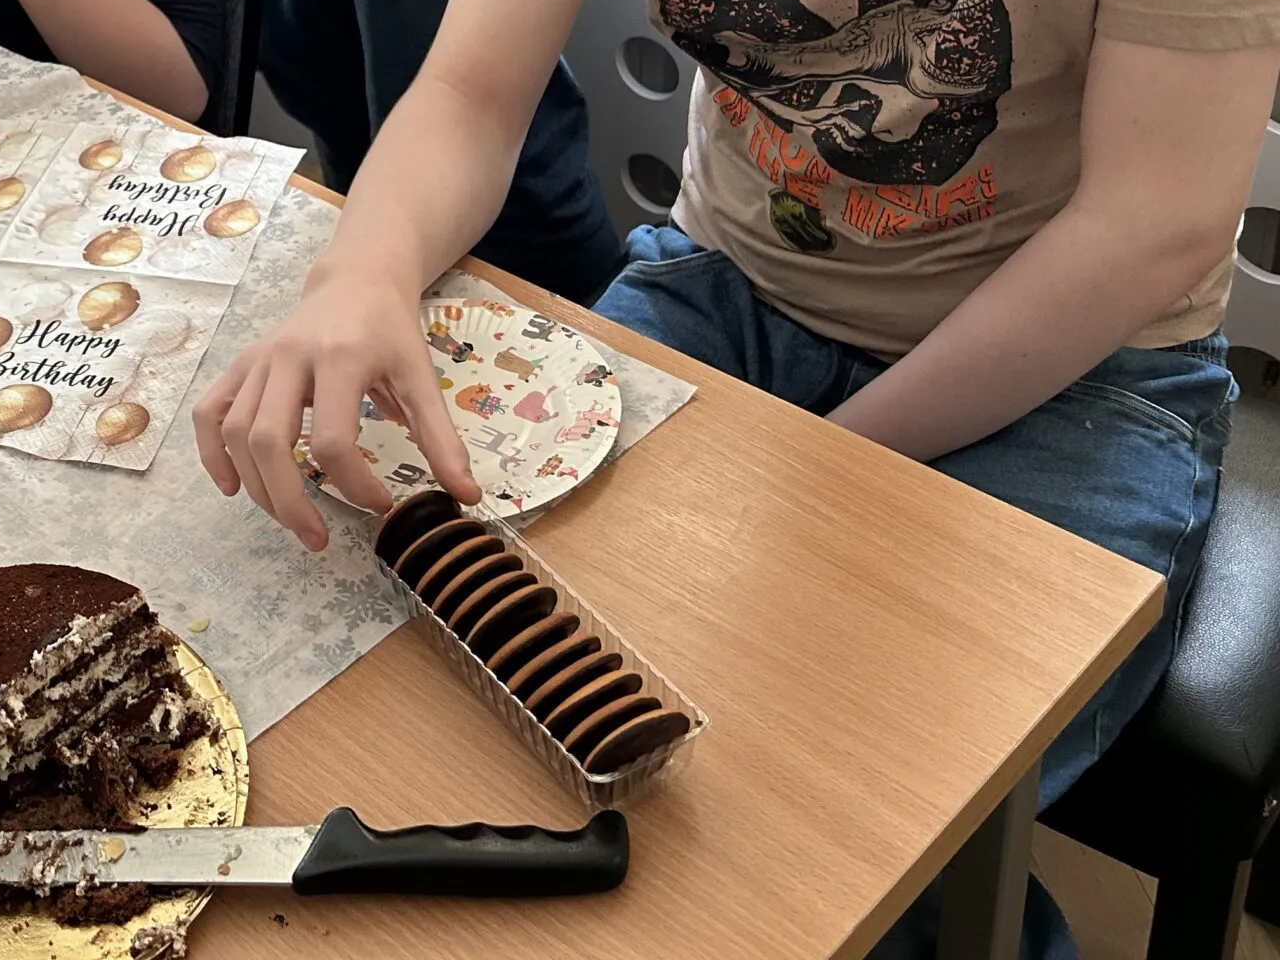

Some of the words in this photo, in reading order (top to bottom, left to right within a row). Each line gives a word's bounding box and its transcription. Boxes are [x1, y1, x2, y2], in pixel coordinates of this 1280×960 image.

[108, 174, 229, 209] Birthday
[98, 203, 202, 237] Happy
[16, 319, 127, 358] Happy
